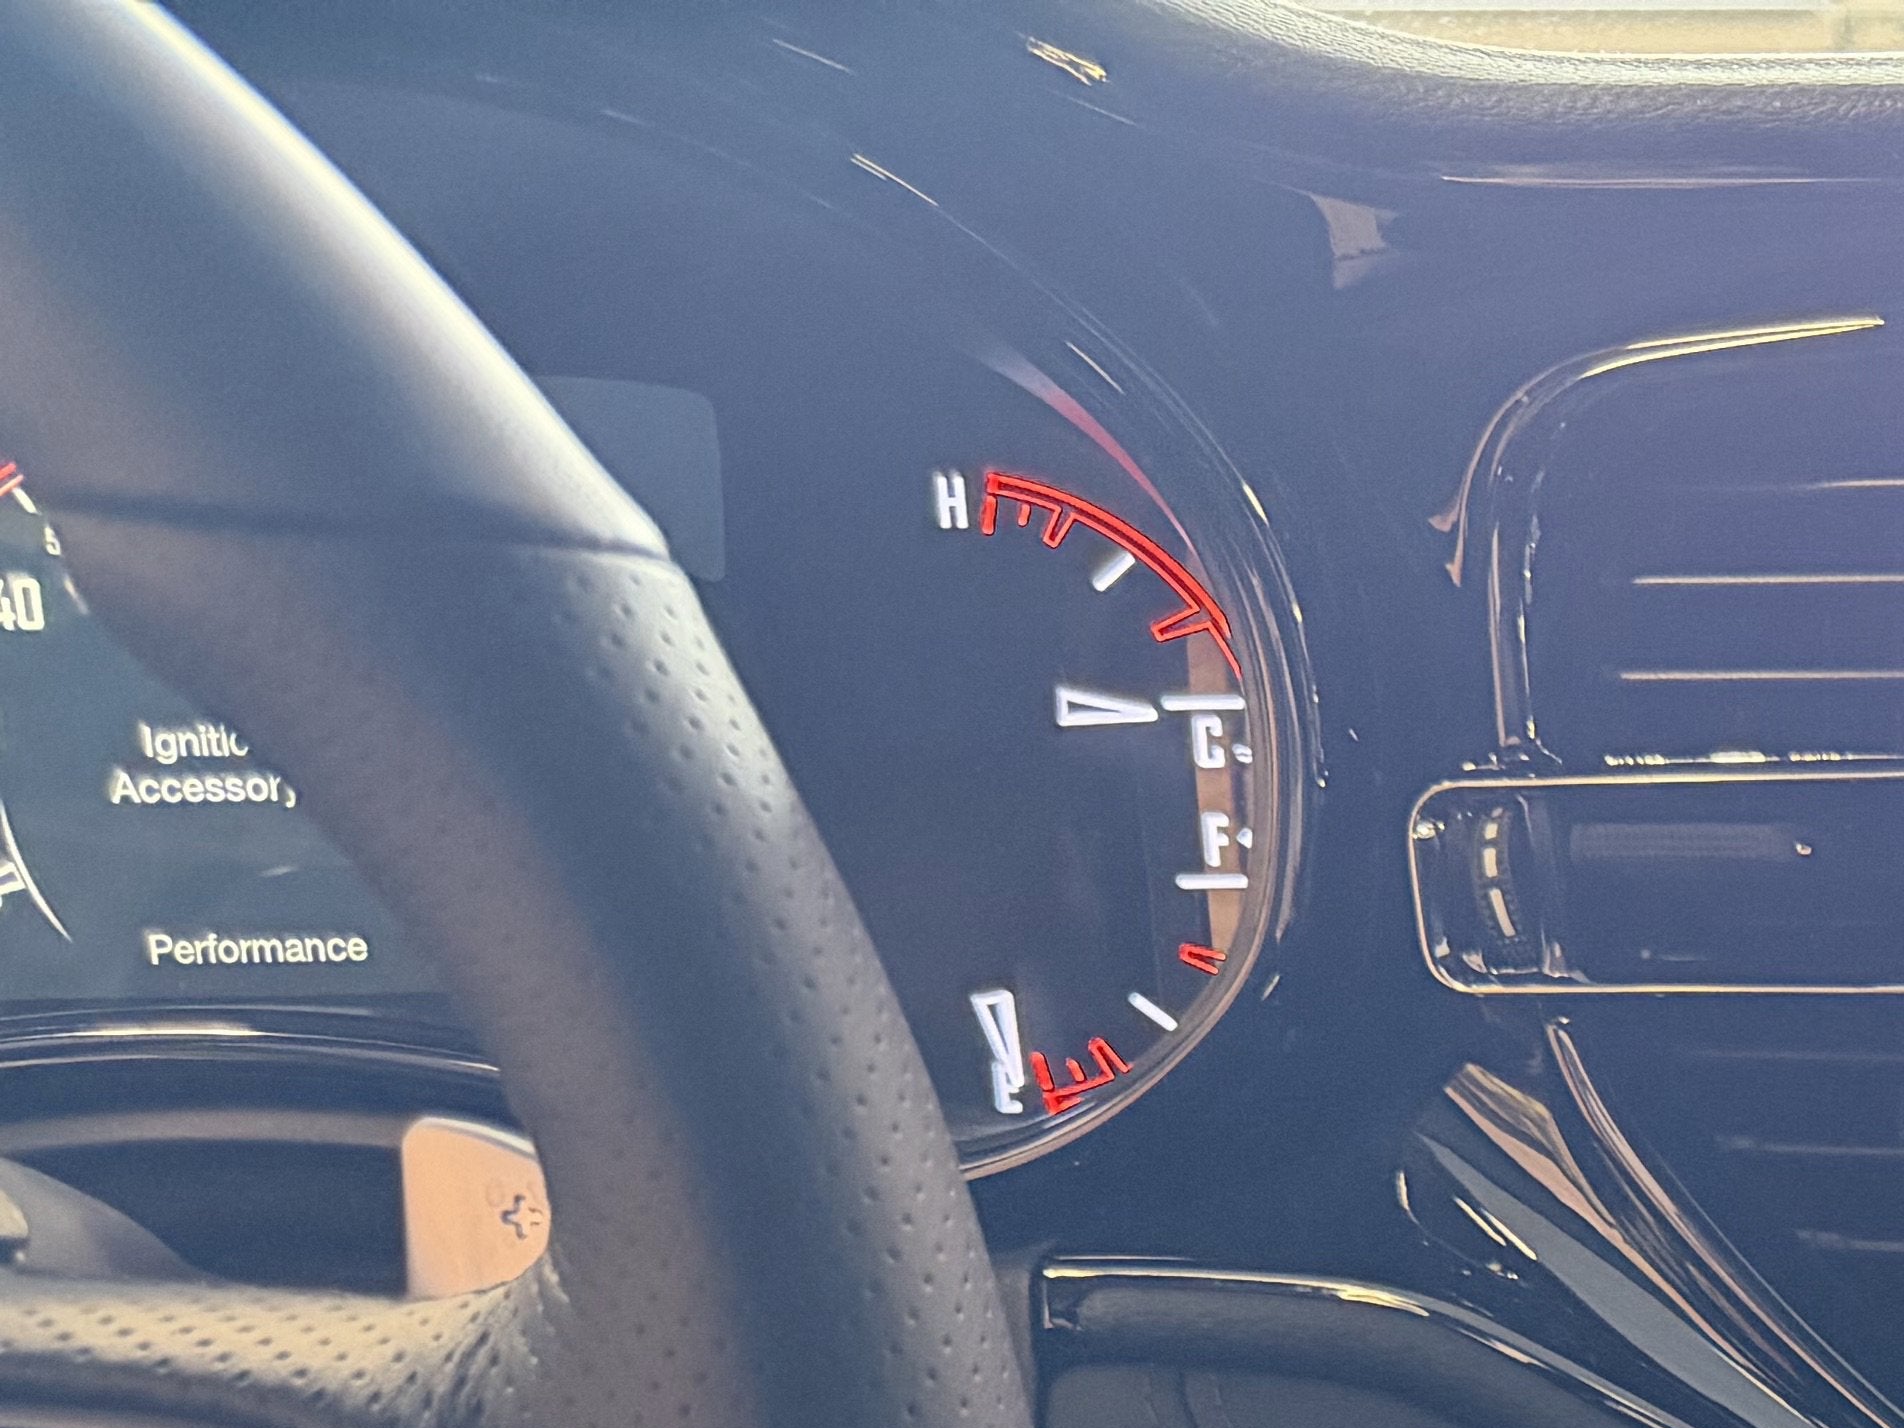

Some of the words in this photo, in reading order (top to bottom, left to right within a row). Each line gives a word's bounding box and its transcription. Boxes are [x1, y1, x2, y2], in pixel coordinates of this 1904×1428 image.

[934, 471, 969, 529] H
[138, 722, 250, 765] Ignitio
[146, 930, 368, 965] Performance
